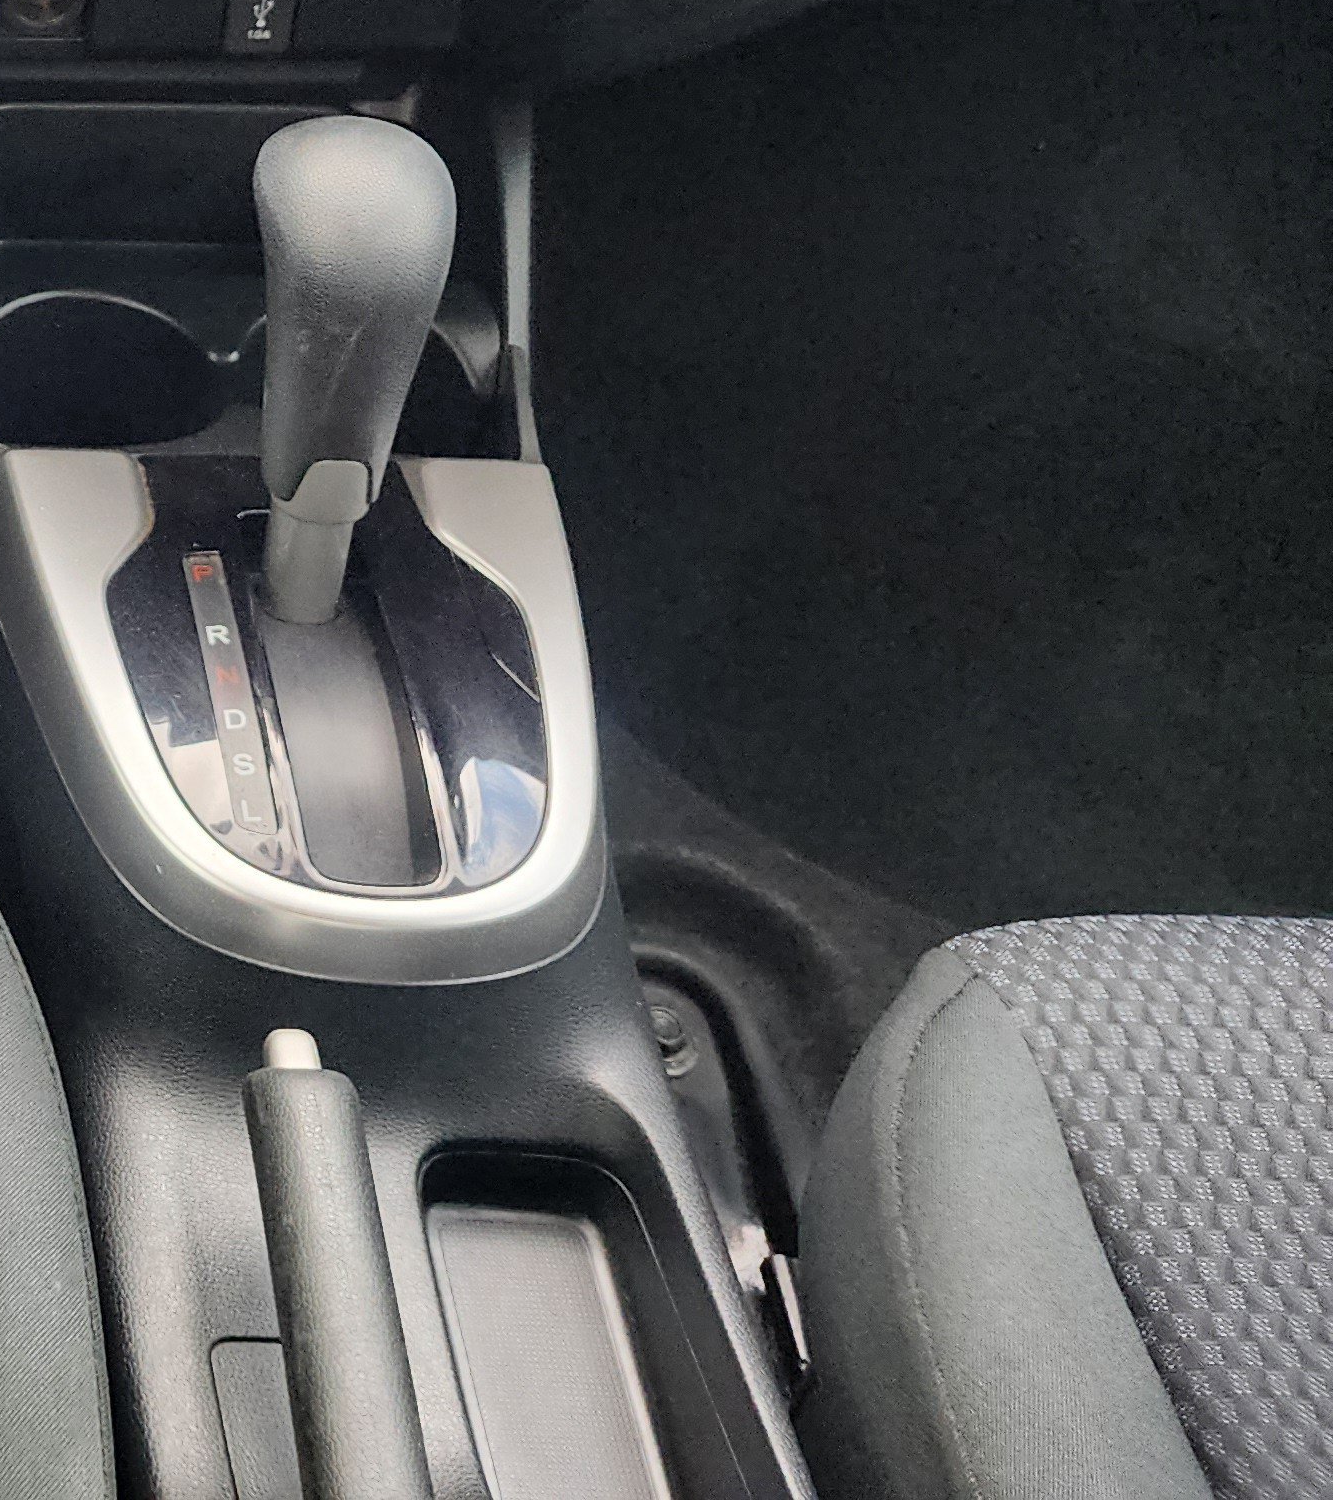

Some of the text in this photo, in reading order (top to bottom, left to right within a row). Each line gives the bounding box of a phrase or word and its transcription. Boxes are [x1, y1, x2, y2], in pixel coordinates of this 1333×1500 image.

[205, 624, 230, 645] R
[223, 708, 247, 730] D
[233, 753, 255, 775] S
[241, 799, 261, 823] L
